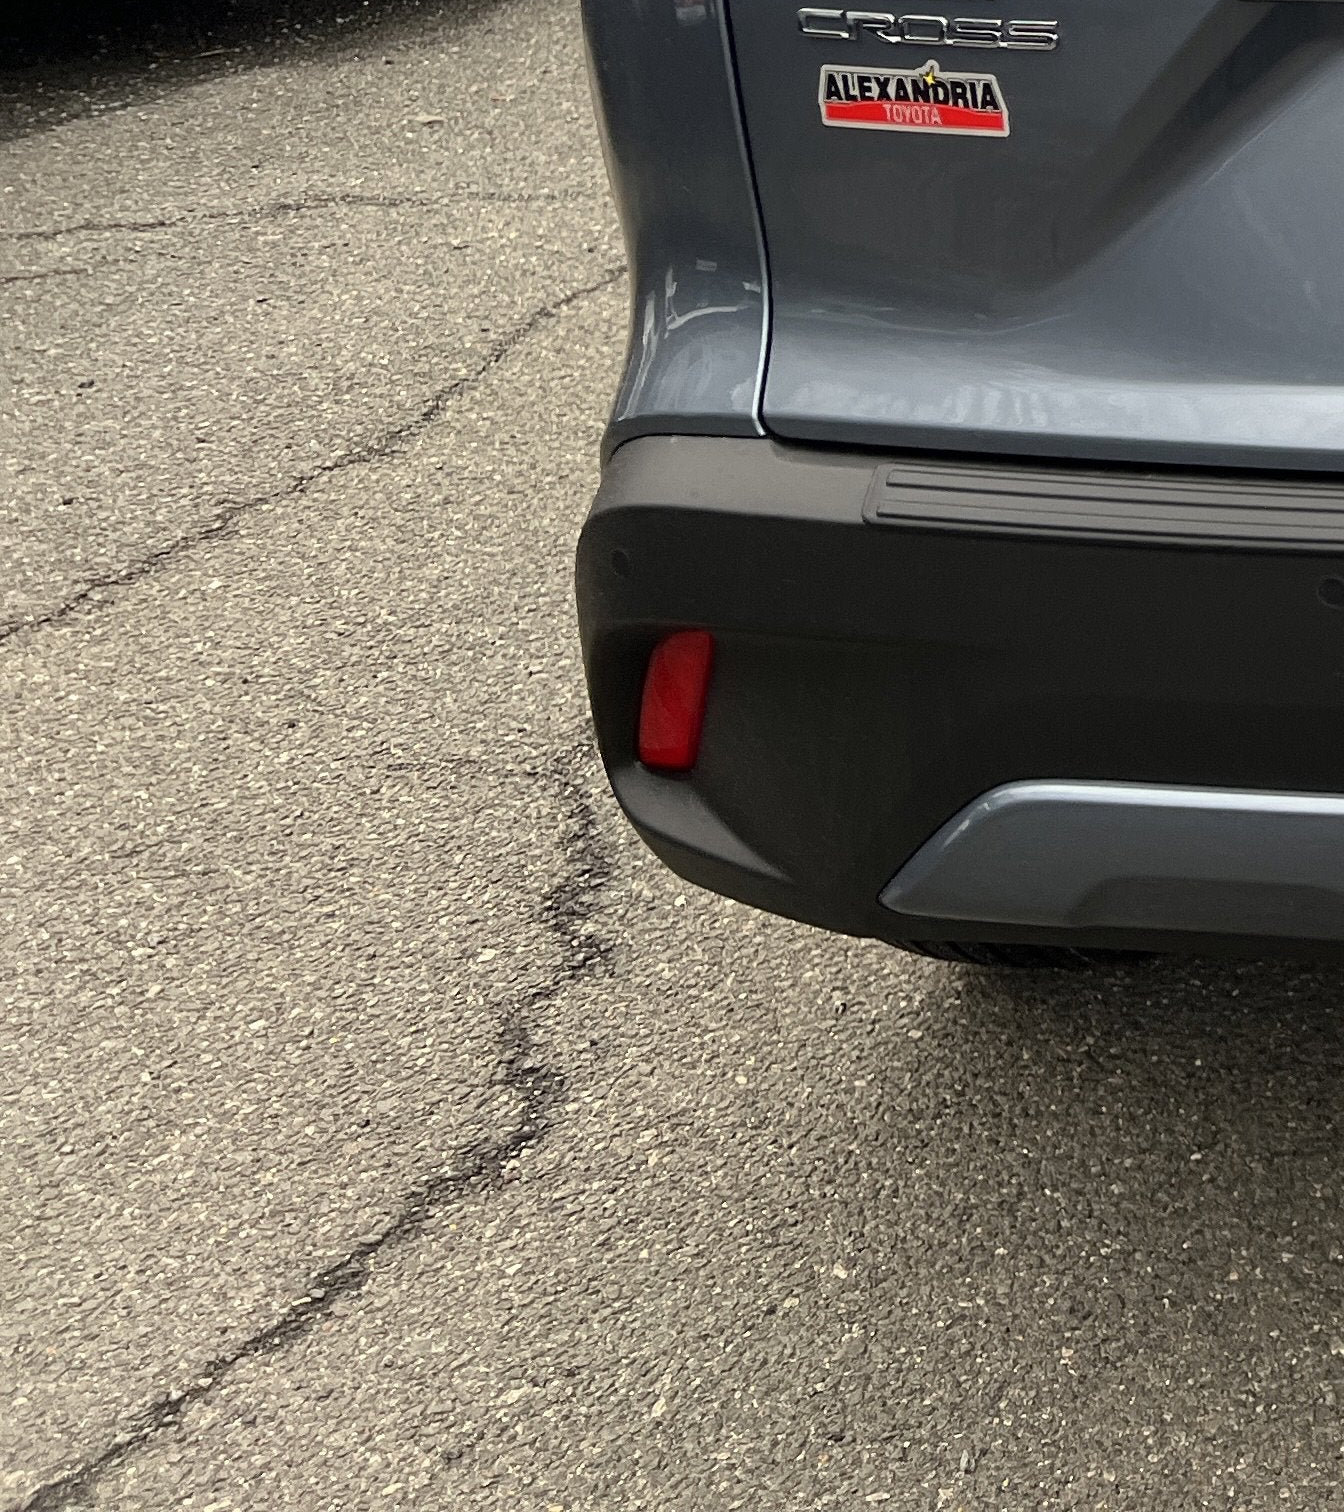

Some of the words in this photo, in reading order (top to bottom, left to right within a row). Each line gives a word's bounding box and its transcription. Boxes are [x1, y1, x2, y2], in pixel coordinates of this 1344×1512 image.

[797, 7, 1059, 51] CROSS
[825, 72, 1000, 111] ALEXANDRIA
[883, 104, 942, 125] TOYOTA
